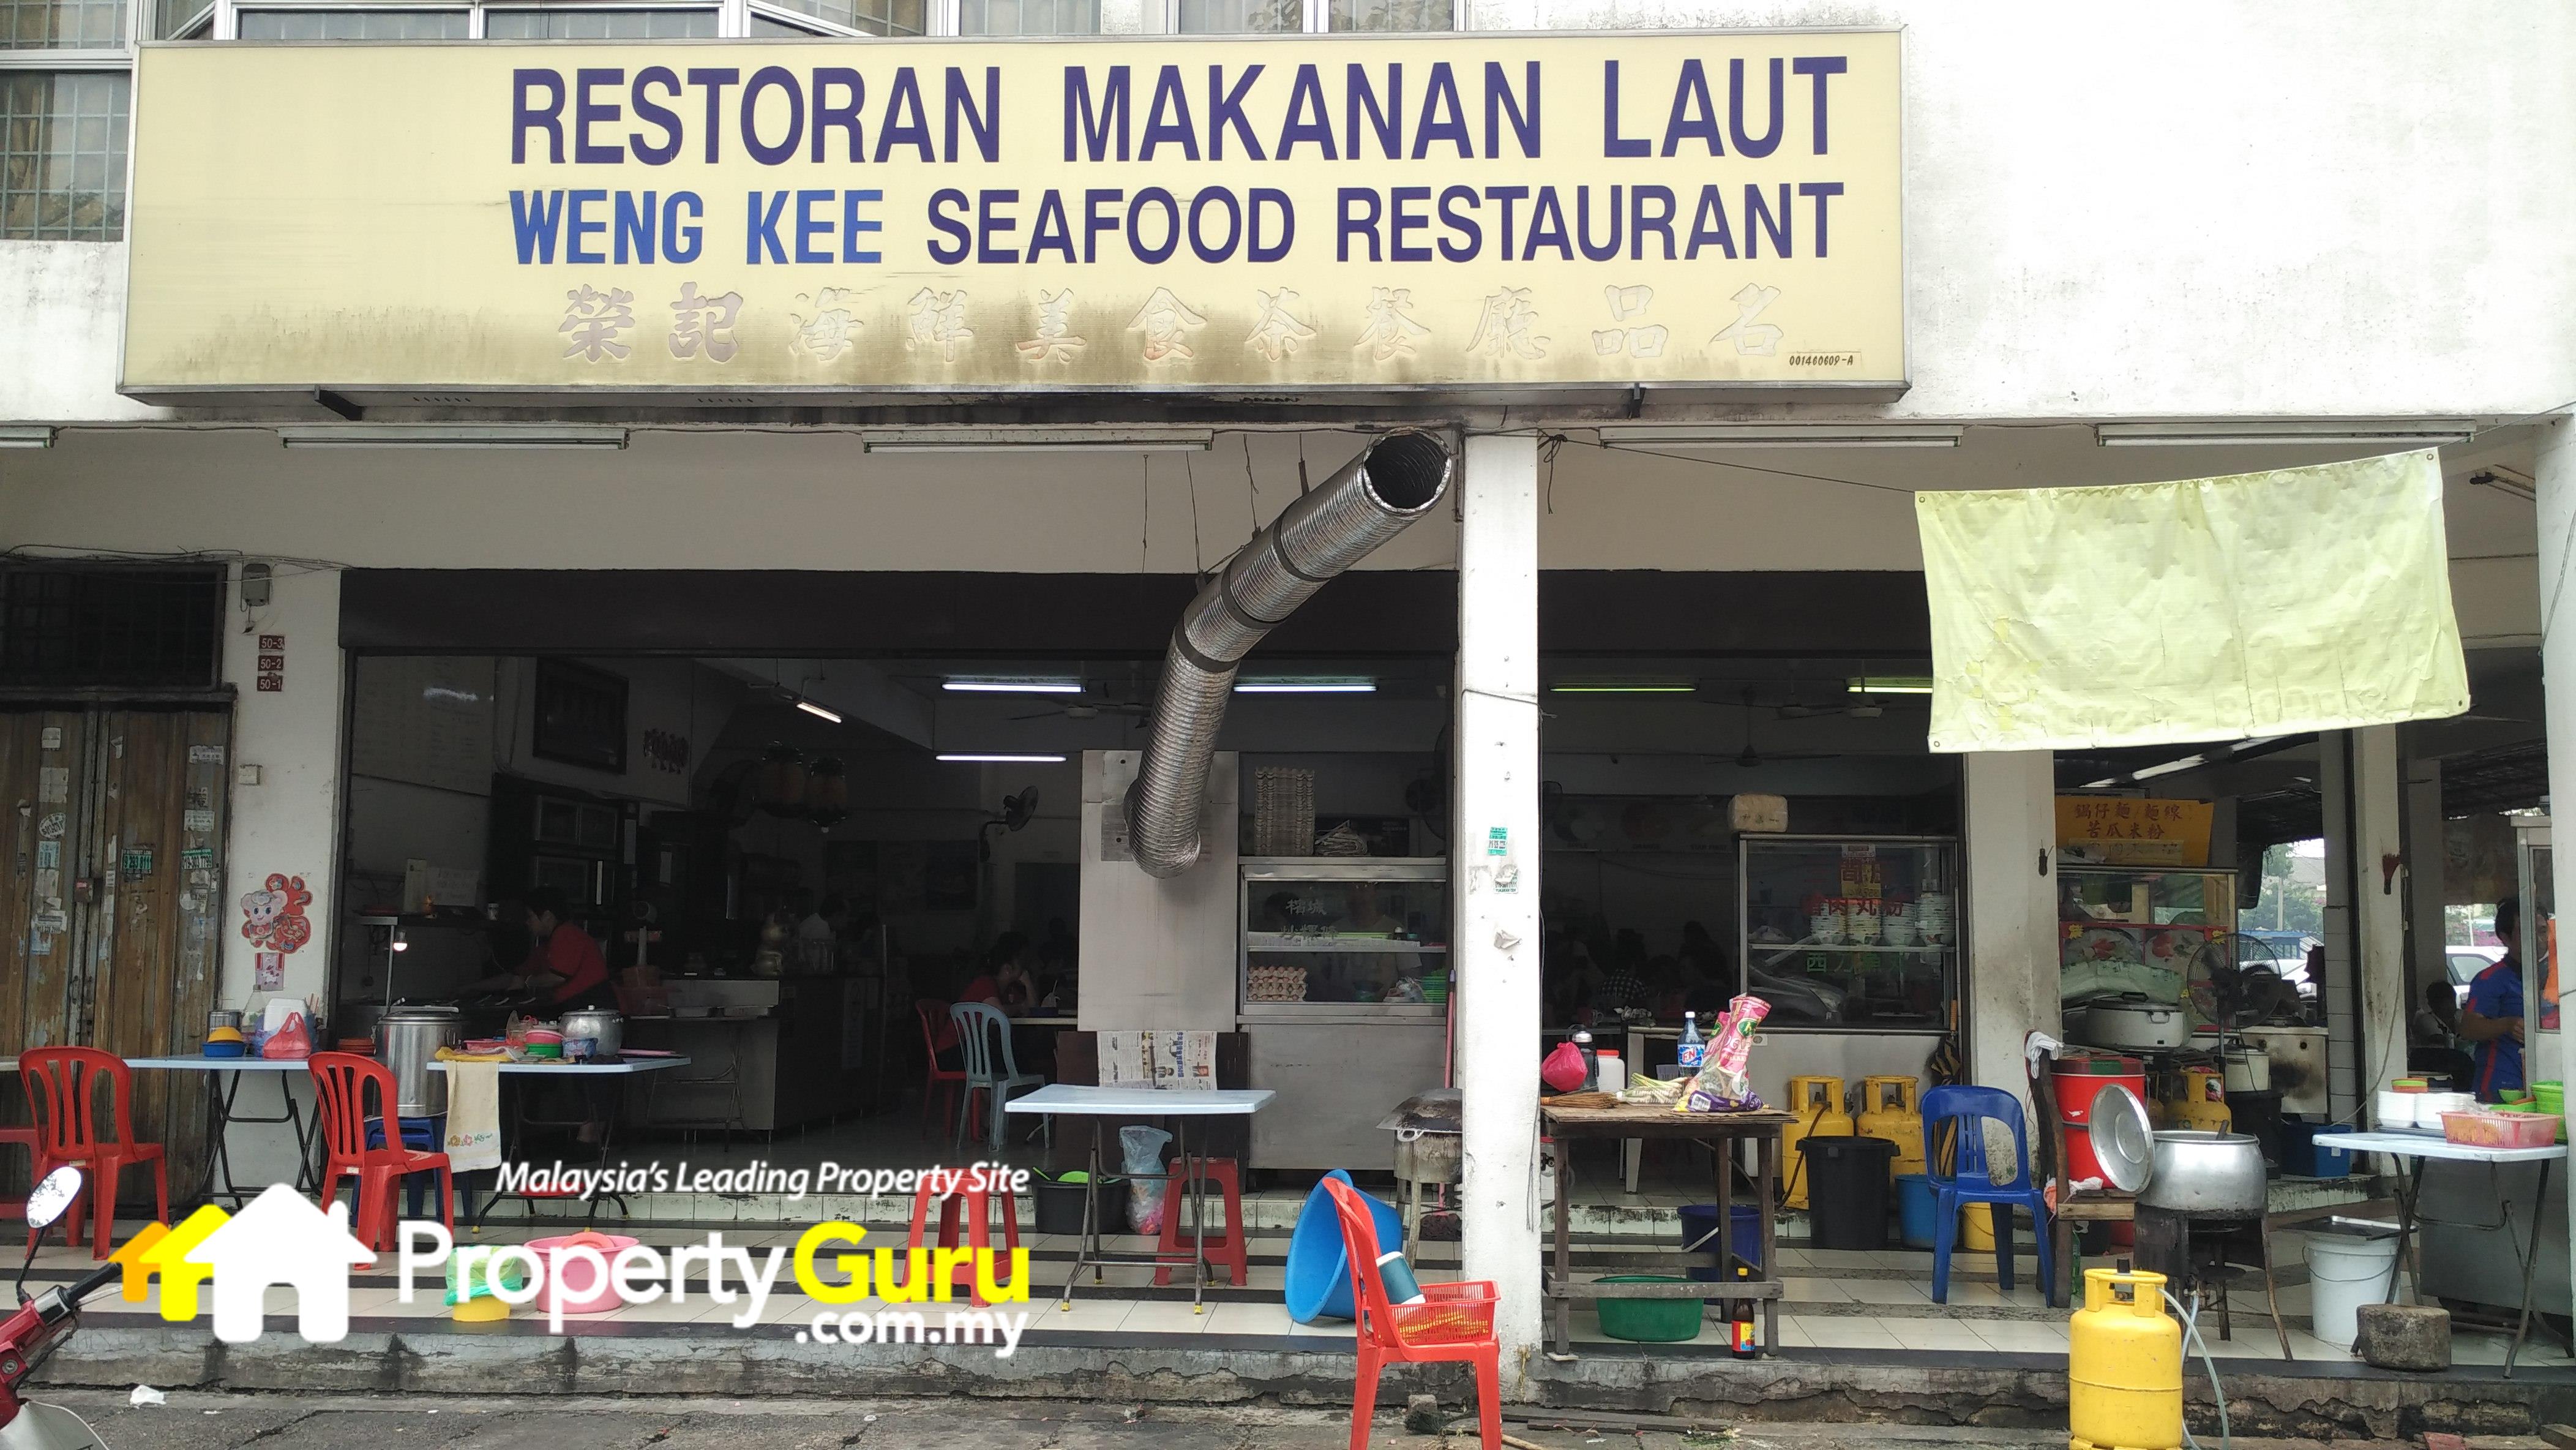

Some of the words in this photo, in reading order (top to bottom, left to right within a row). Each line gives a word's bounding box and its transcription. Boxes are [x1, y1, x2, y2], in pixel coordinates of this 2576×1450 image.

[513, 66, 999, 165] RESTORAN
[1065, 61, 1541, 162] MAKANAN
[1604, 56, 1848, 158] LAUT
[509, 189, 703, 265] WENG
[747, 189, 883, 265] KEE
[927, 186, 1295, 264] SEAFOOD
[1337, 182, 1845, 262] RESTAURANT
[261, 638, 282, 648] 50-3
[260, 658, 282, 669] 50-2
[260, 678, 281, 689] 50-1
[2086, 820, 2165, 840] 苦瓜米粉
